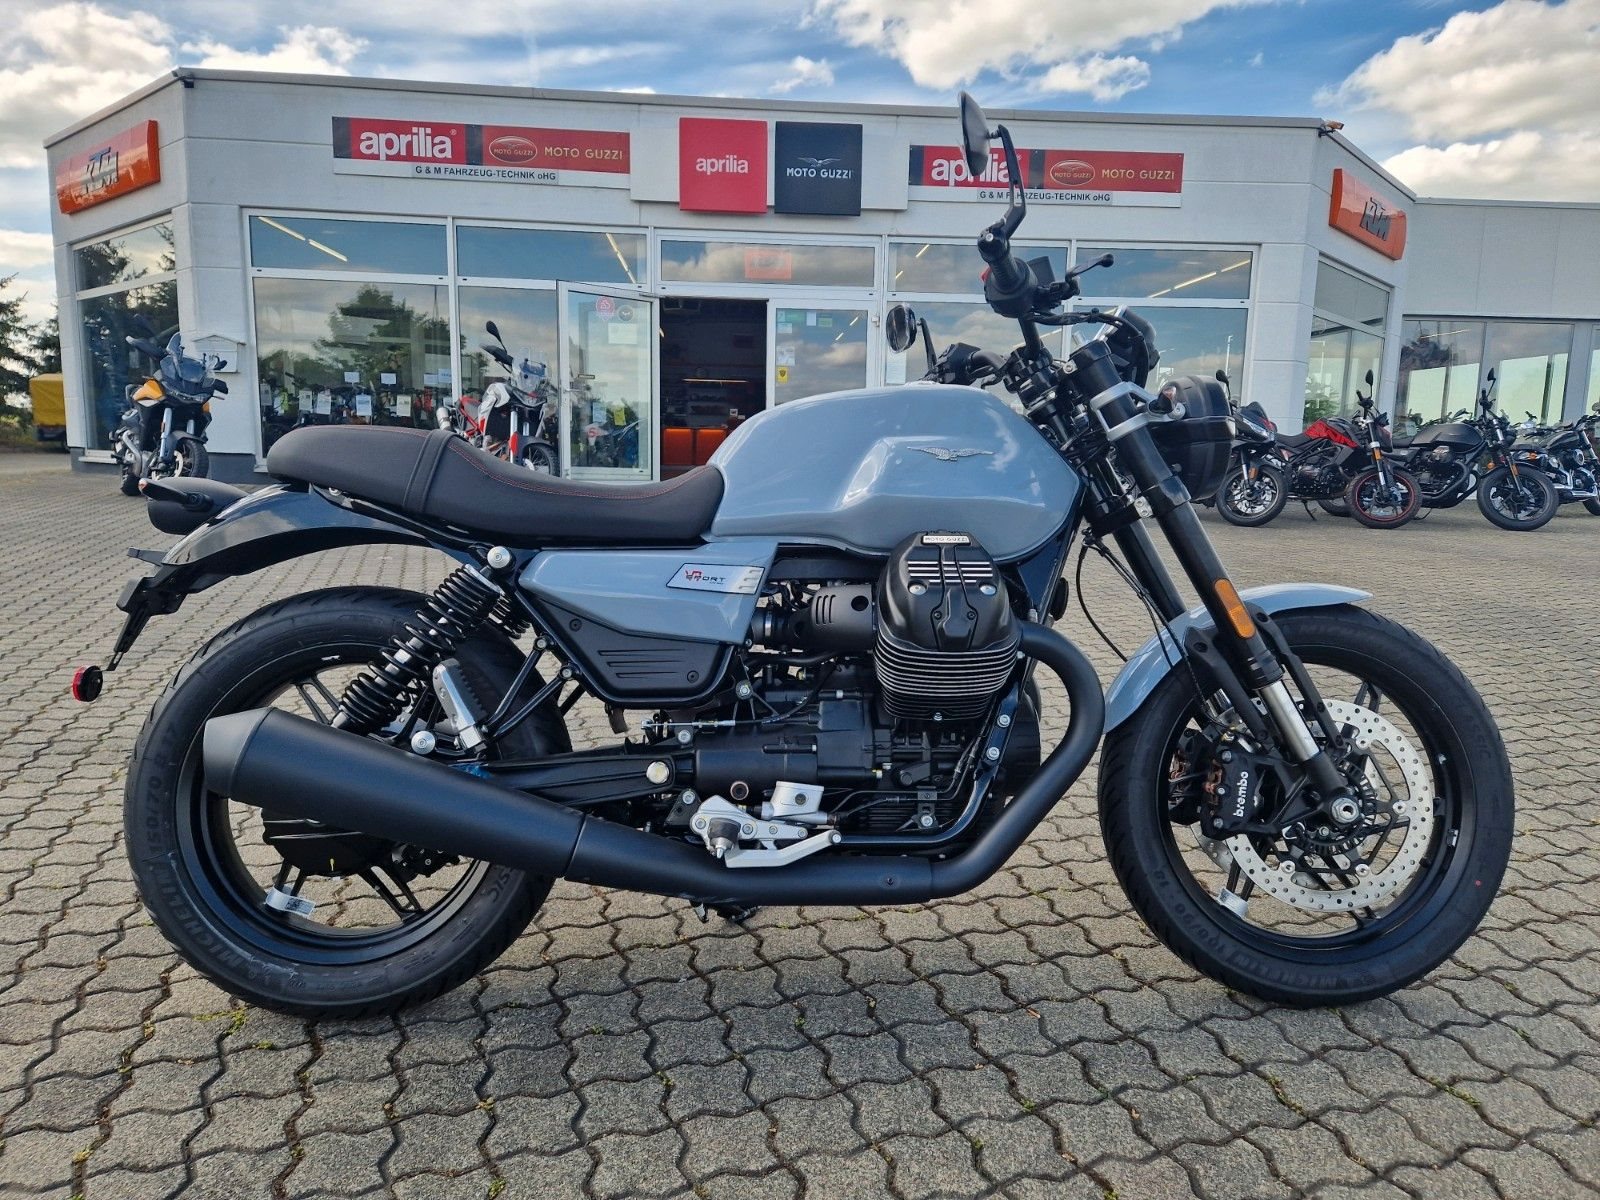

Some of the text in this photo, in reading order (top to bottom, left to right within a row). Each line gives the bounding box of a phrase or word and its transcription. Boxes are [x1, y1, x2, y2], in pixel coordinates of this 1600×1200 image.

[359, 127, 452, 160] aprilia
[544, 146, 623, 160] MOTO GUZZI
[415, 165, 556, 180] G & M FAHRZEUG-TECHNIK oHG
[695, 155, 749, 175] aprilia
[786, 167, 852, 179] MOTO GUZZI
[931, 153, 1011, 187] aplia
[1101, 169, 1175, 180] MOTO GUZZI
[979, 190, 987, 199] G
[988, 191, 995, 199] &
[996, 191, 1004, 199] M
[1006, 191, 1091, 202] FHRZEUG-TECHNIK
[1233, 771, 1249, 817] brembo
[154, 864, 244, 969] MICHELIN
